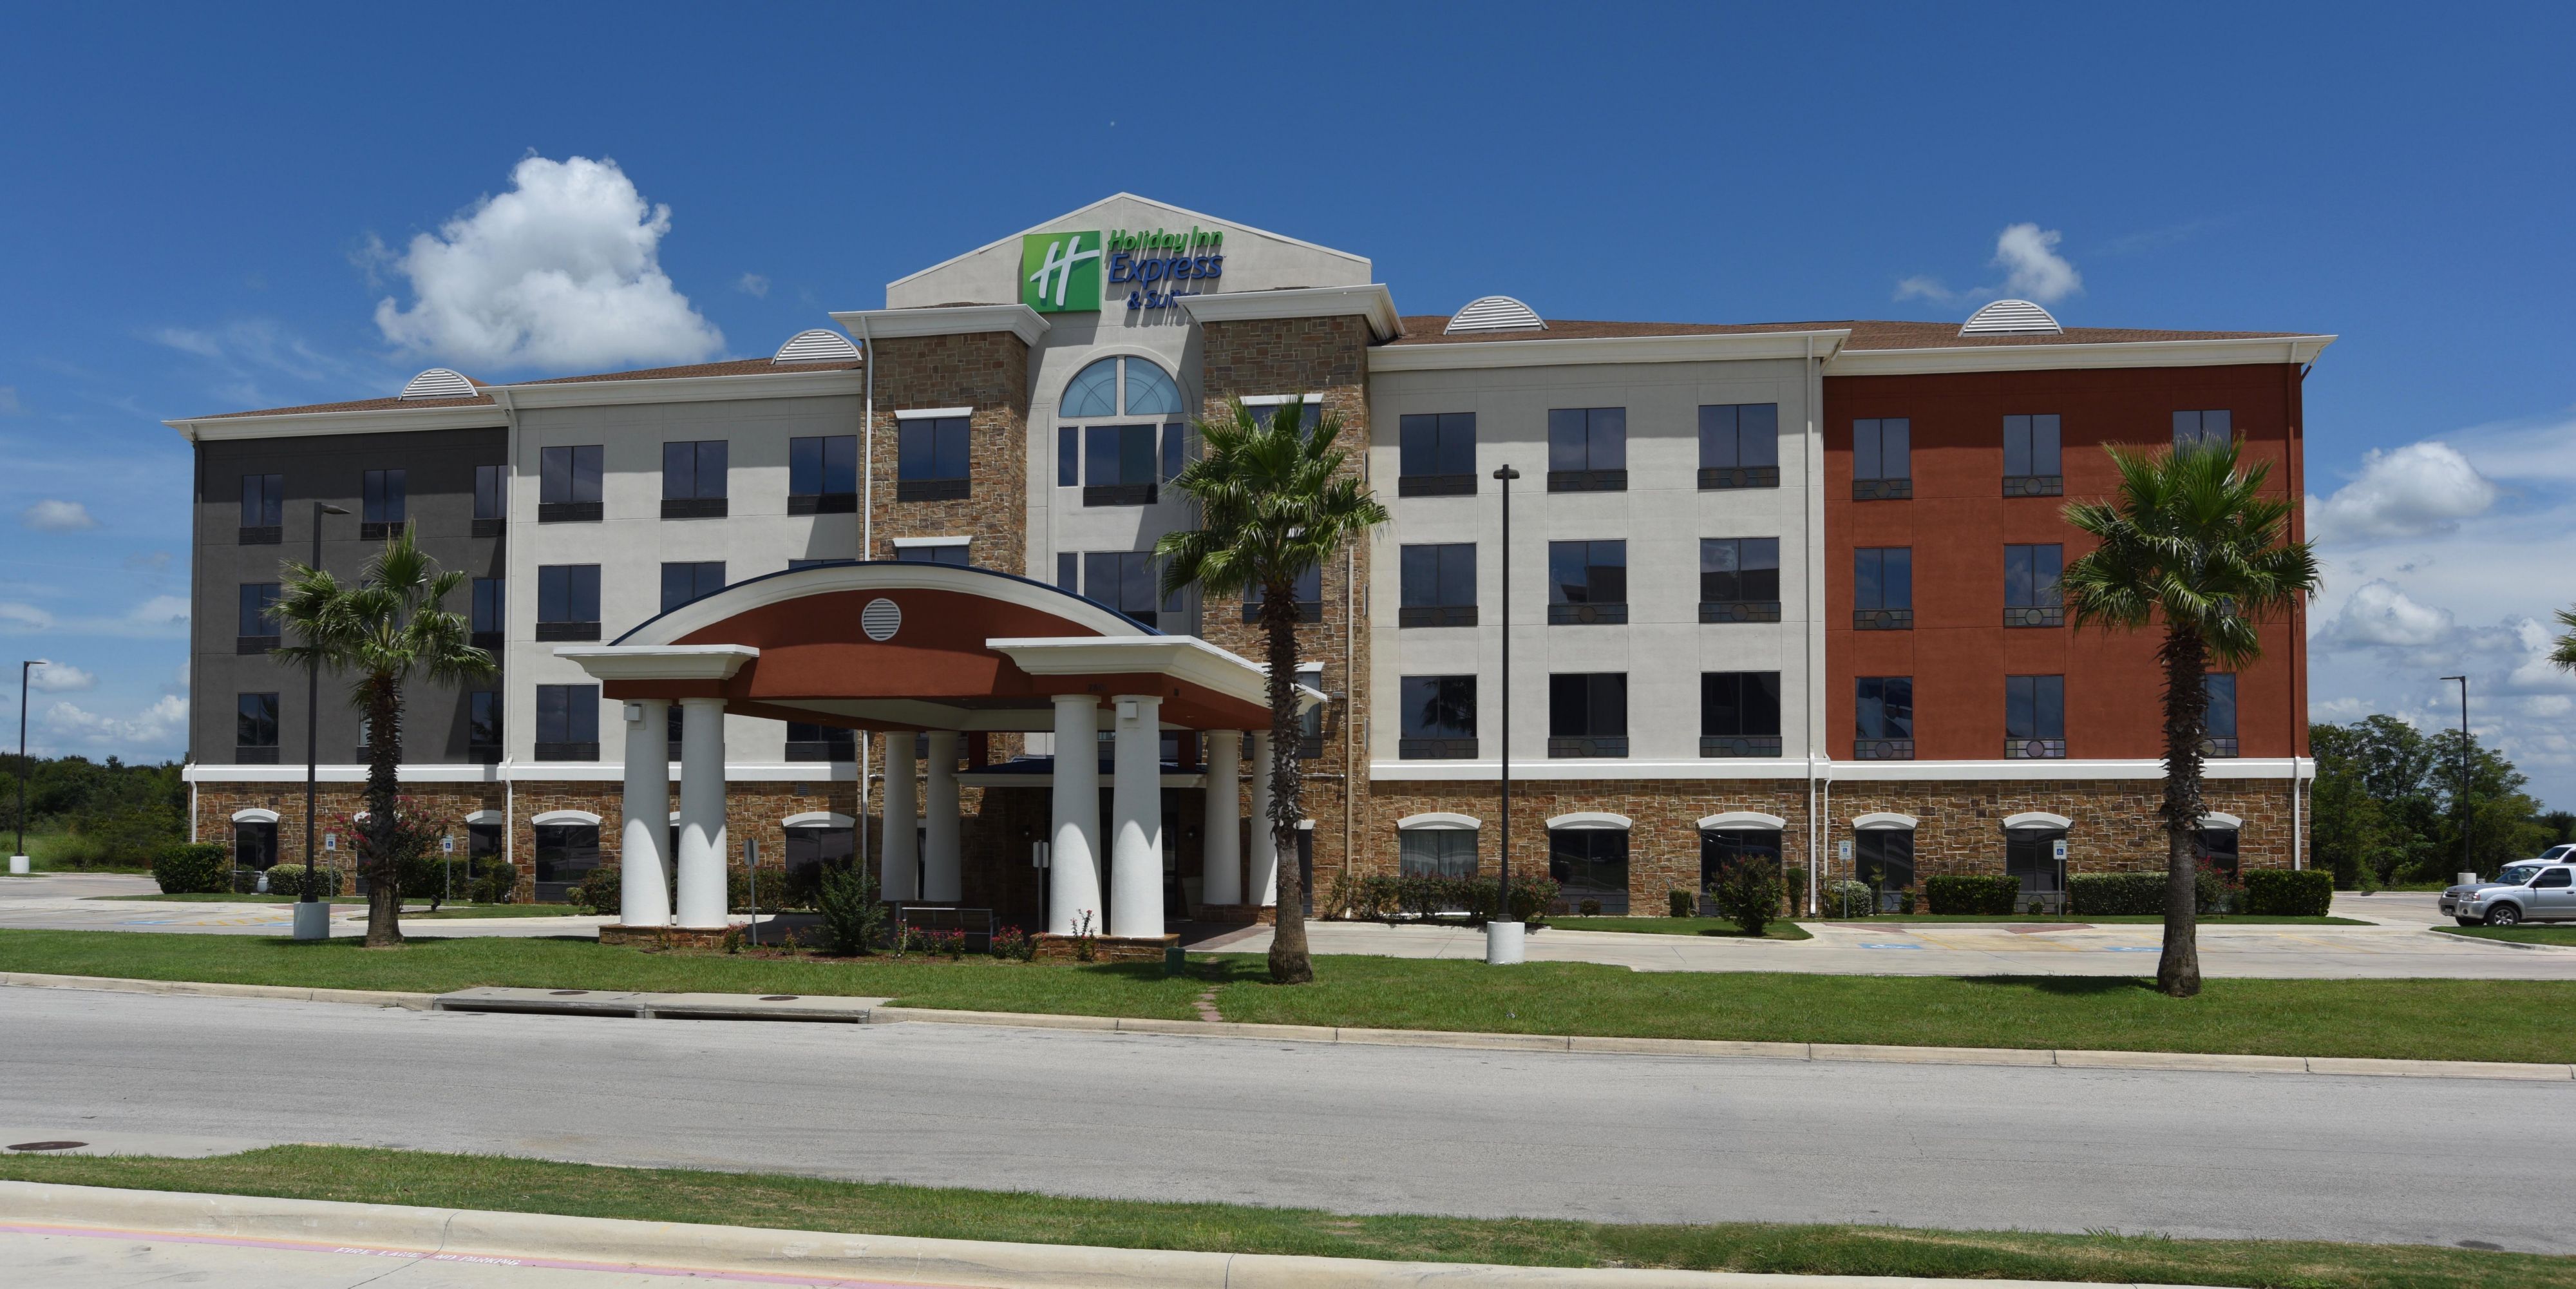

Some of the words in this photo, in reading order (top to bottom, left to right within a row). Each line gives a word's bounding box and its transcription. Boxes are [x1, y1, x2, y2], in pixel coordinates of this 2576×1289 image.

[1108, 229, 1188, 252] Holiday
[1190, 225, 1223, 247] Inn
[1108, 253, 1223, 289] Express
[1127, 291, 1141, 310] &
[459, 1256, 521, 1265] PARKING
